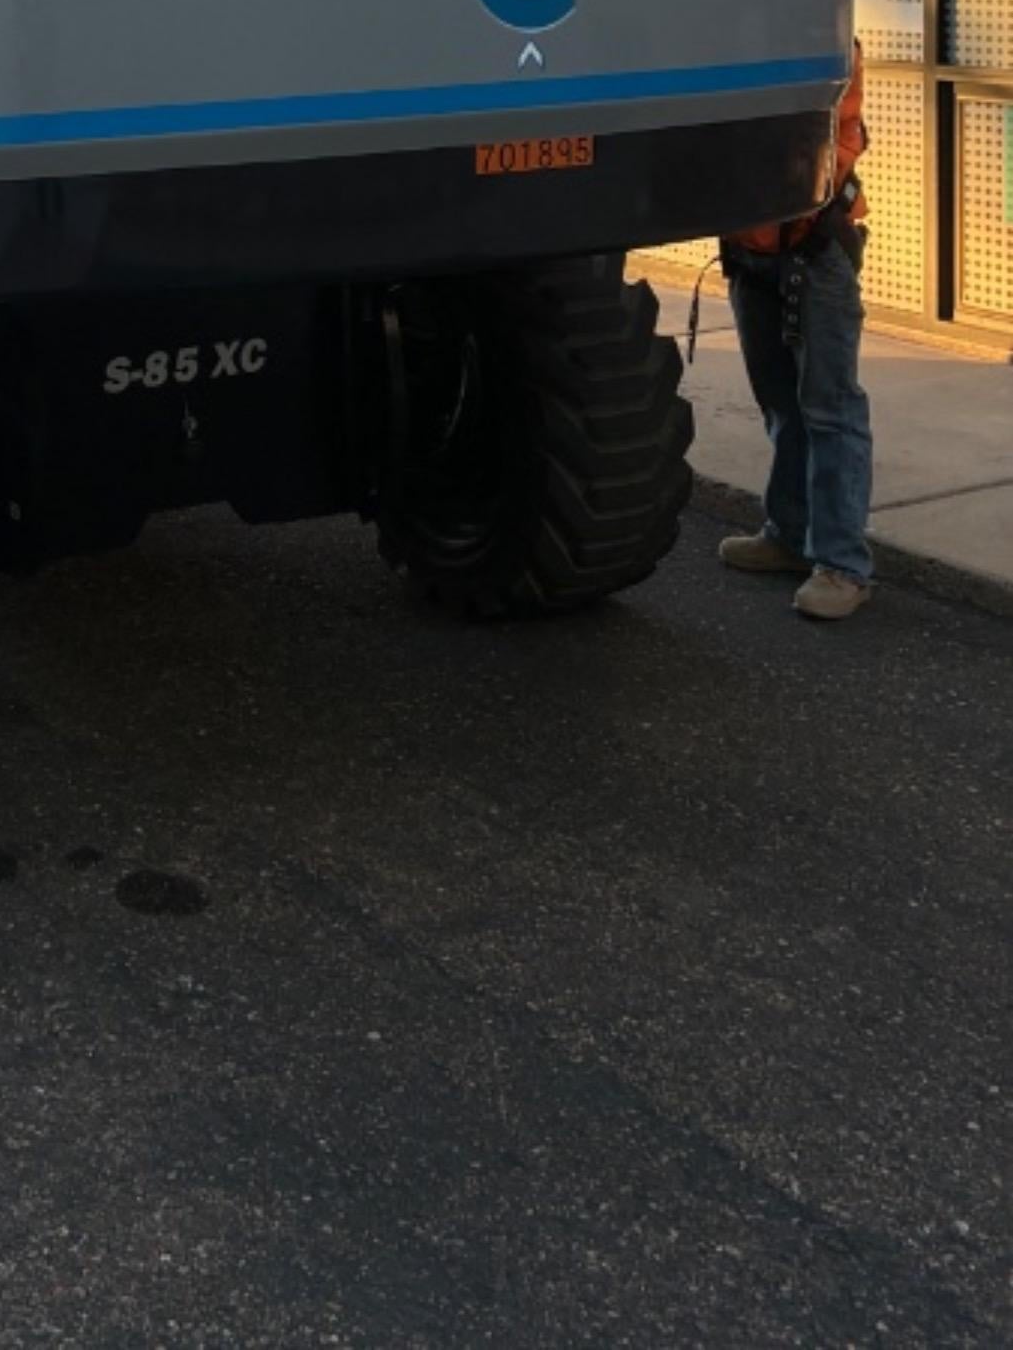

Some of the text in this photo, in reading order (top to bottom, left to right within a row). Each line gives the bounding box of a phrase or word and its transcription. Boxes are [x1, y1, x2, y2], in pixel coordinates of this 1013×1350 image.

[478, 136, 592, 174] 701895
[102, 337, 268, 394] S-85 XC
